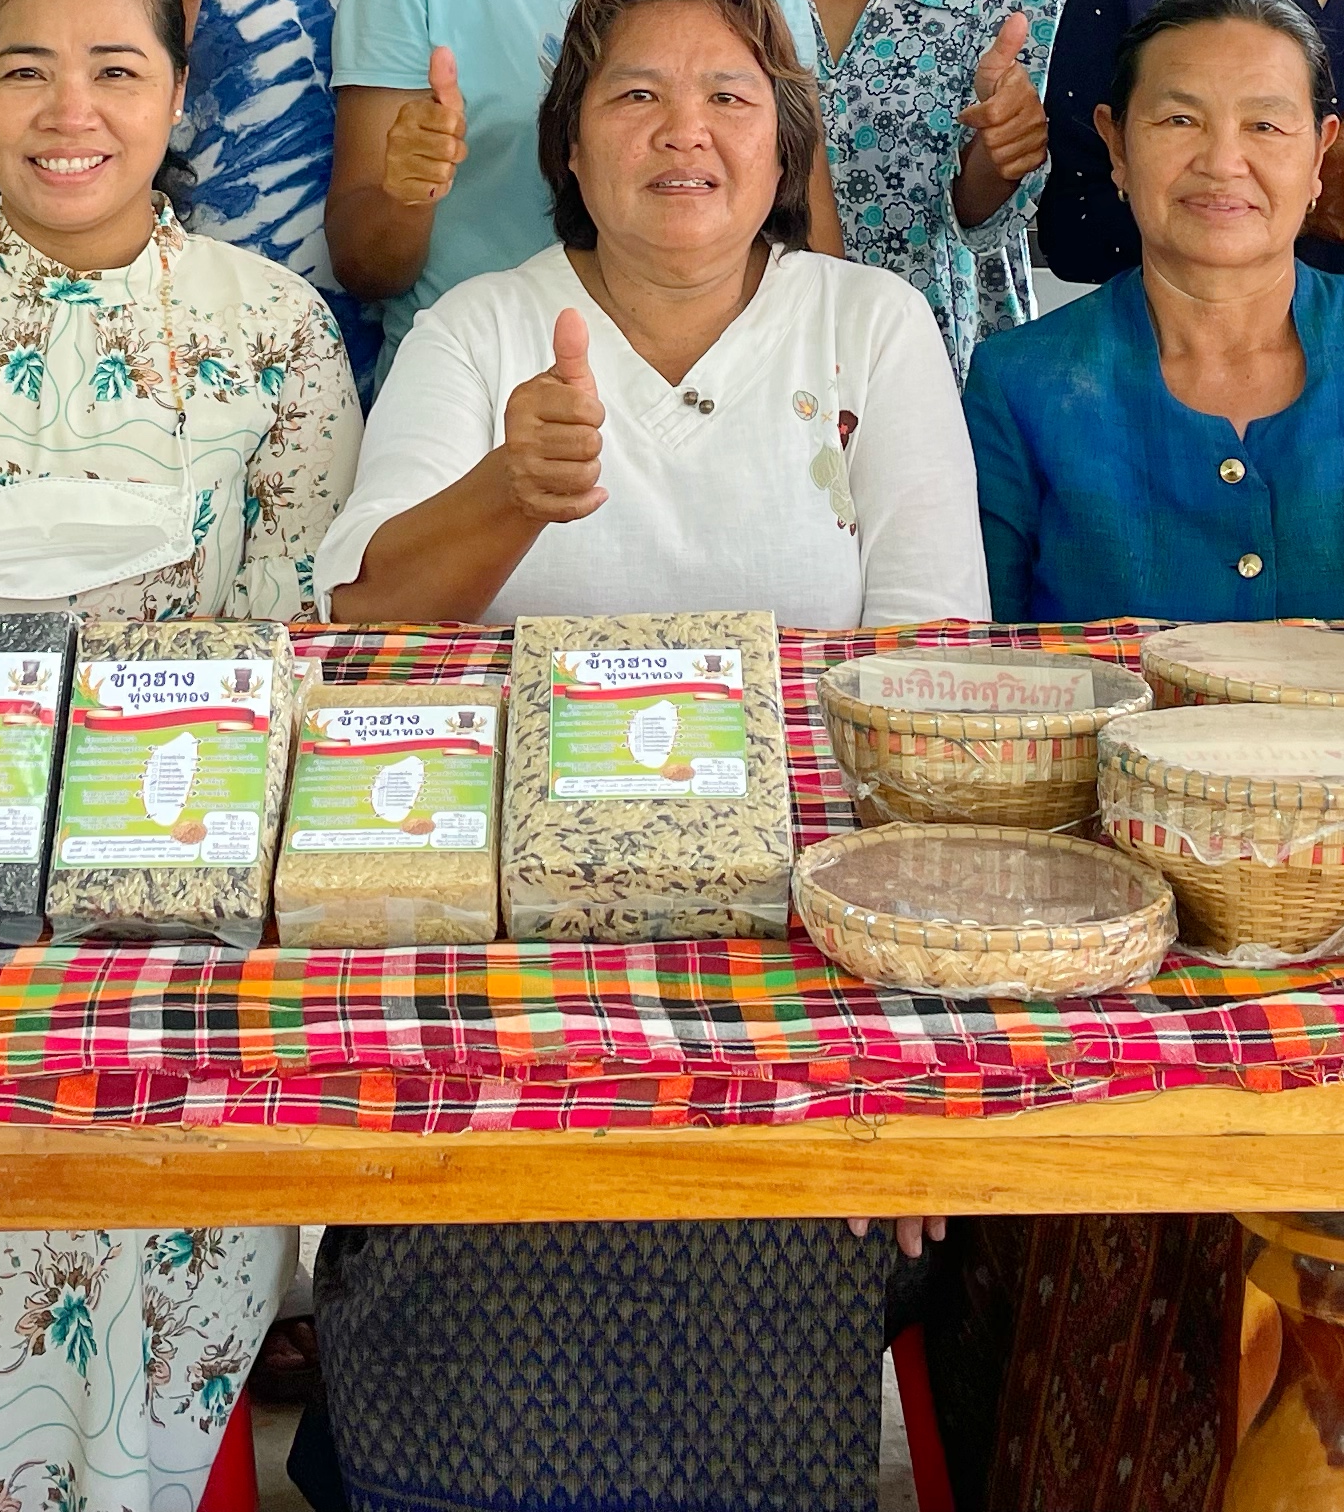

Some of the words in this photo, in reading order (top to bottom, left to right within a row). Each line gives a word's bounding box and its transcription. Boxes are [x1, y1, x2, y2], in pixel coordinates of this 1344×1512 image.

[586, 652, 667, 669] ข้าวฮาง
[110, 664, 195, 687] ข้าวฮาง
[605, 668, 683, 685] ทุ่งนาทอง
[128, 687, 210, 709] ทุ่งนาทอง
[338, 710, 420, 726] ข้าวฮาง
[355, 725, 435, 741] ทุ่งนาทอง
